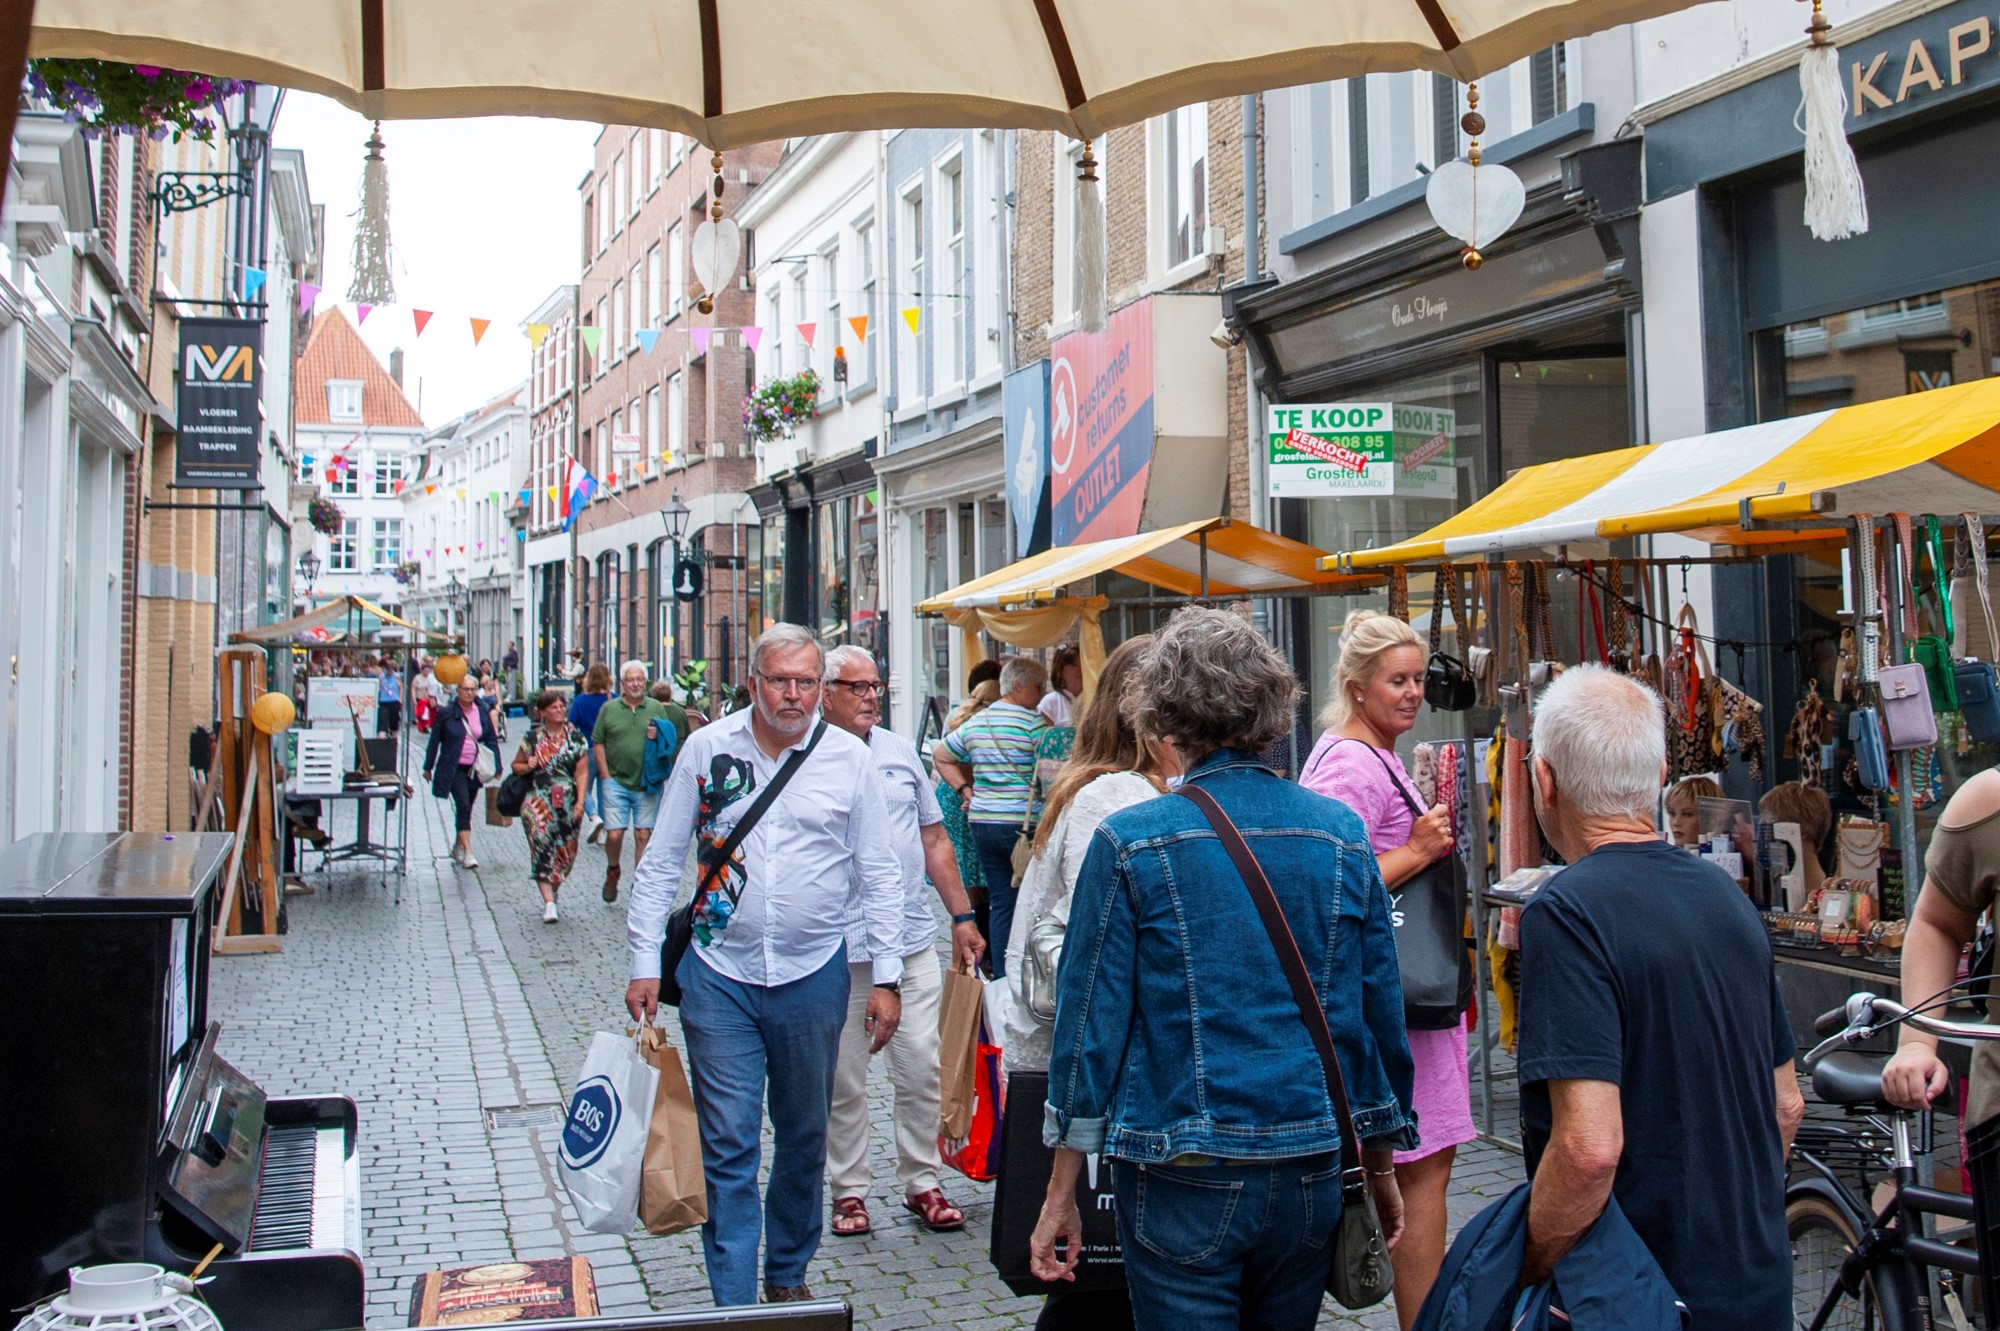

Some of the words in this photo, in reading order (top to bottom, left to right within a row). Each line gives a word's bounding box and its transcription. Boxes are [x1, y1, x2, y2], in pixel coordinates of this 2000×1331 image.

[1077, 340, 1131, 427] customer
[199, 408, 238, 417] VLOEREN
[1086, 386, 1127, 454] returns
[1274, 410, 1302, 429] TE
[1311, 408, 1383, 428] KOOP
[183, 424, 253, 435] RAAMBEKLEDING
[1364, 435, 1384, 448] 95
[198, 442, 237, 451] TRAPPEN
[1292, 429, 1364, 465] VERKOCHT
[1074, 444, 1121, 524] OUTLET
[574, 1099, 605, 1132] BOS
